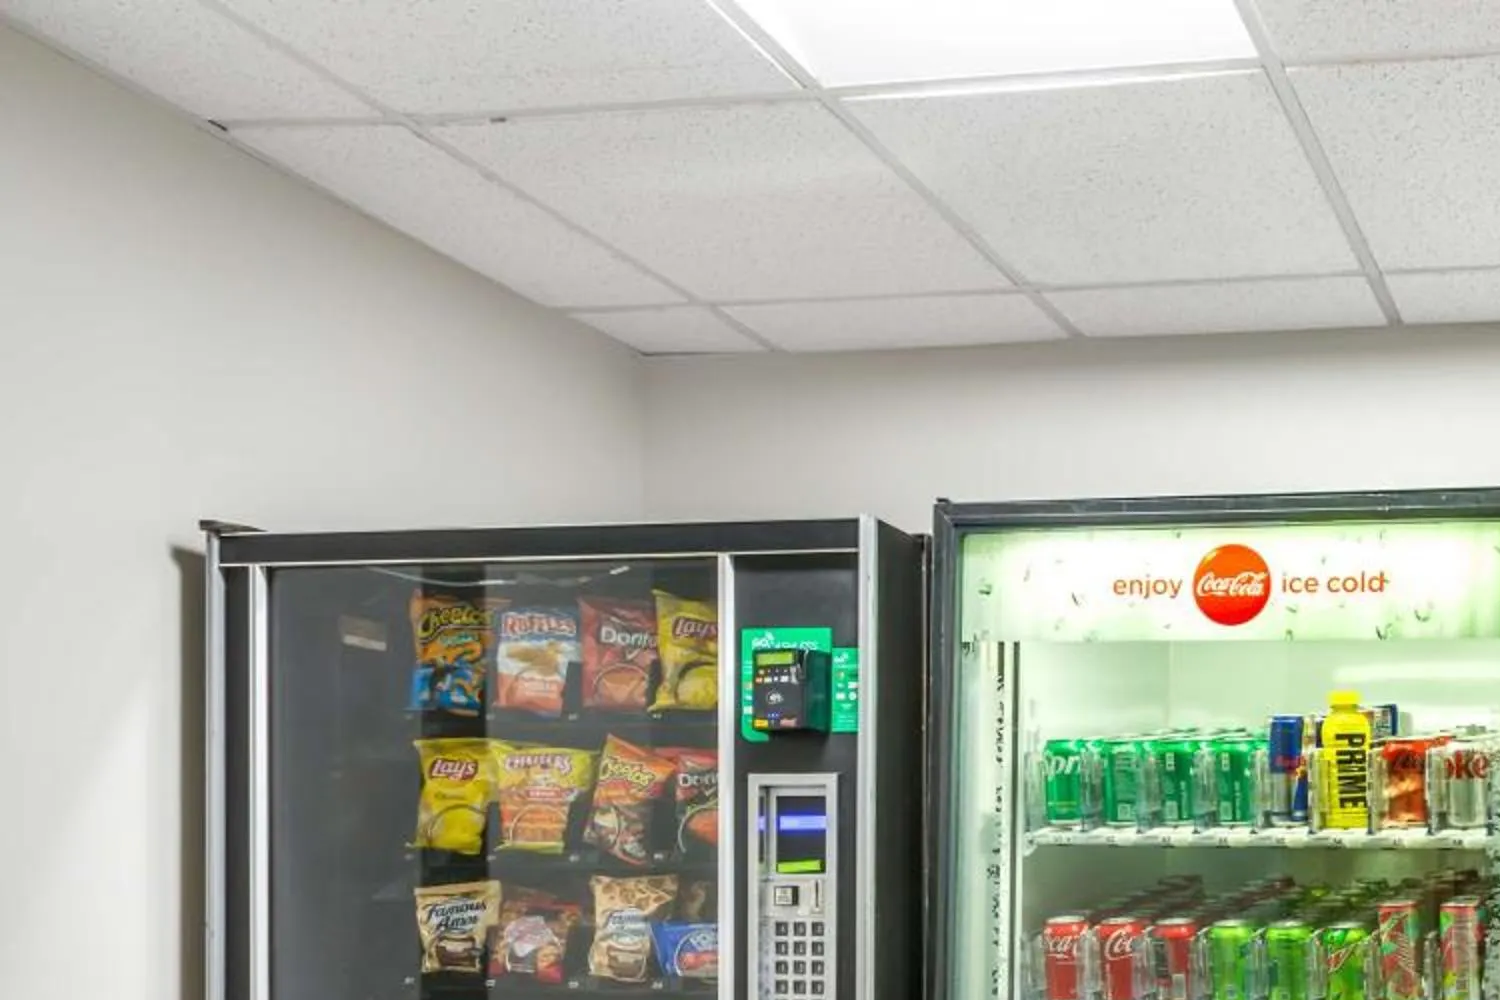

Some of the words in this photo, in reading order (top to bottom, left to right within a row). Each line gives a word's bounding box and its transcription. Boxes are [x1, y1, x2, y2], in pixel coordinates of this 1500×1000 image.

[1112, 577, 1183, 599] enjoy
[1281, 572, 1319, 593] ice
[1327, 571, 1385, 593] cold
[1335, 733, 1368, 808] PRIME
